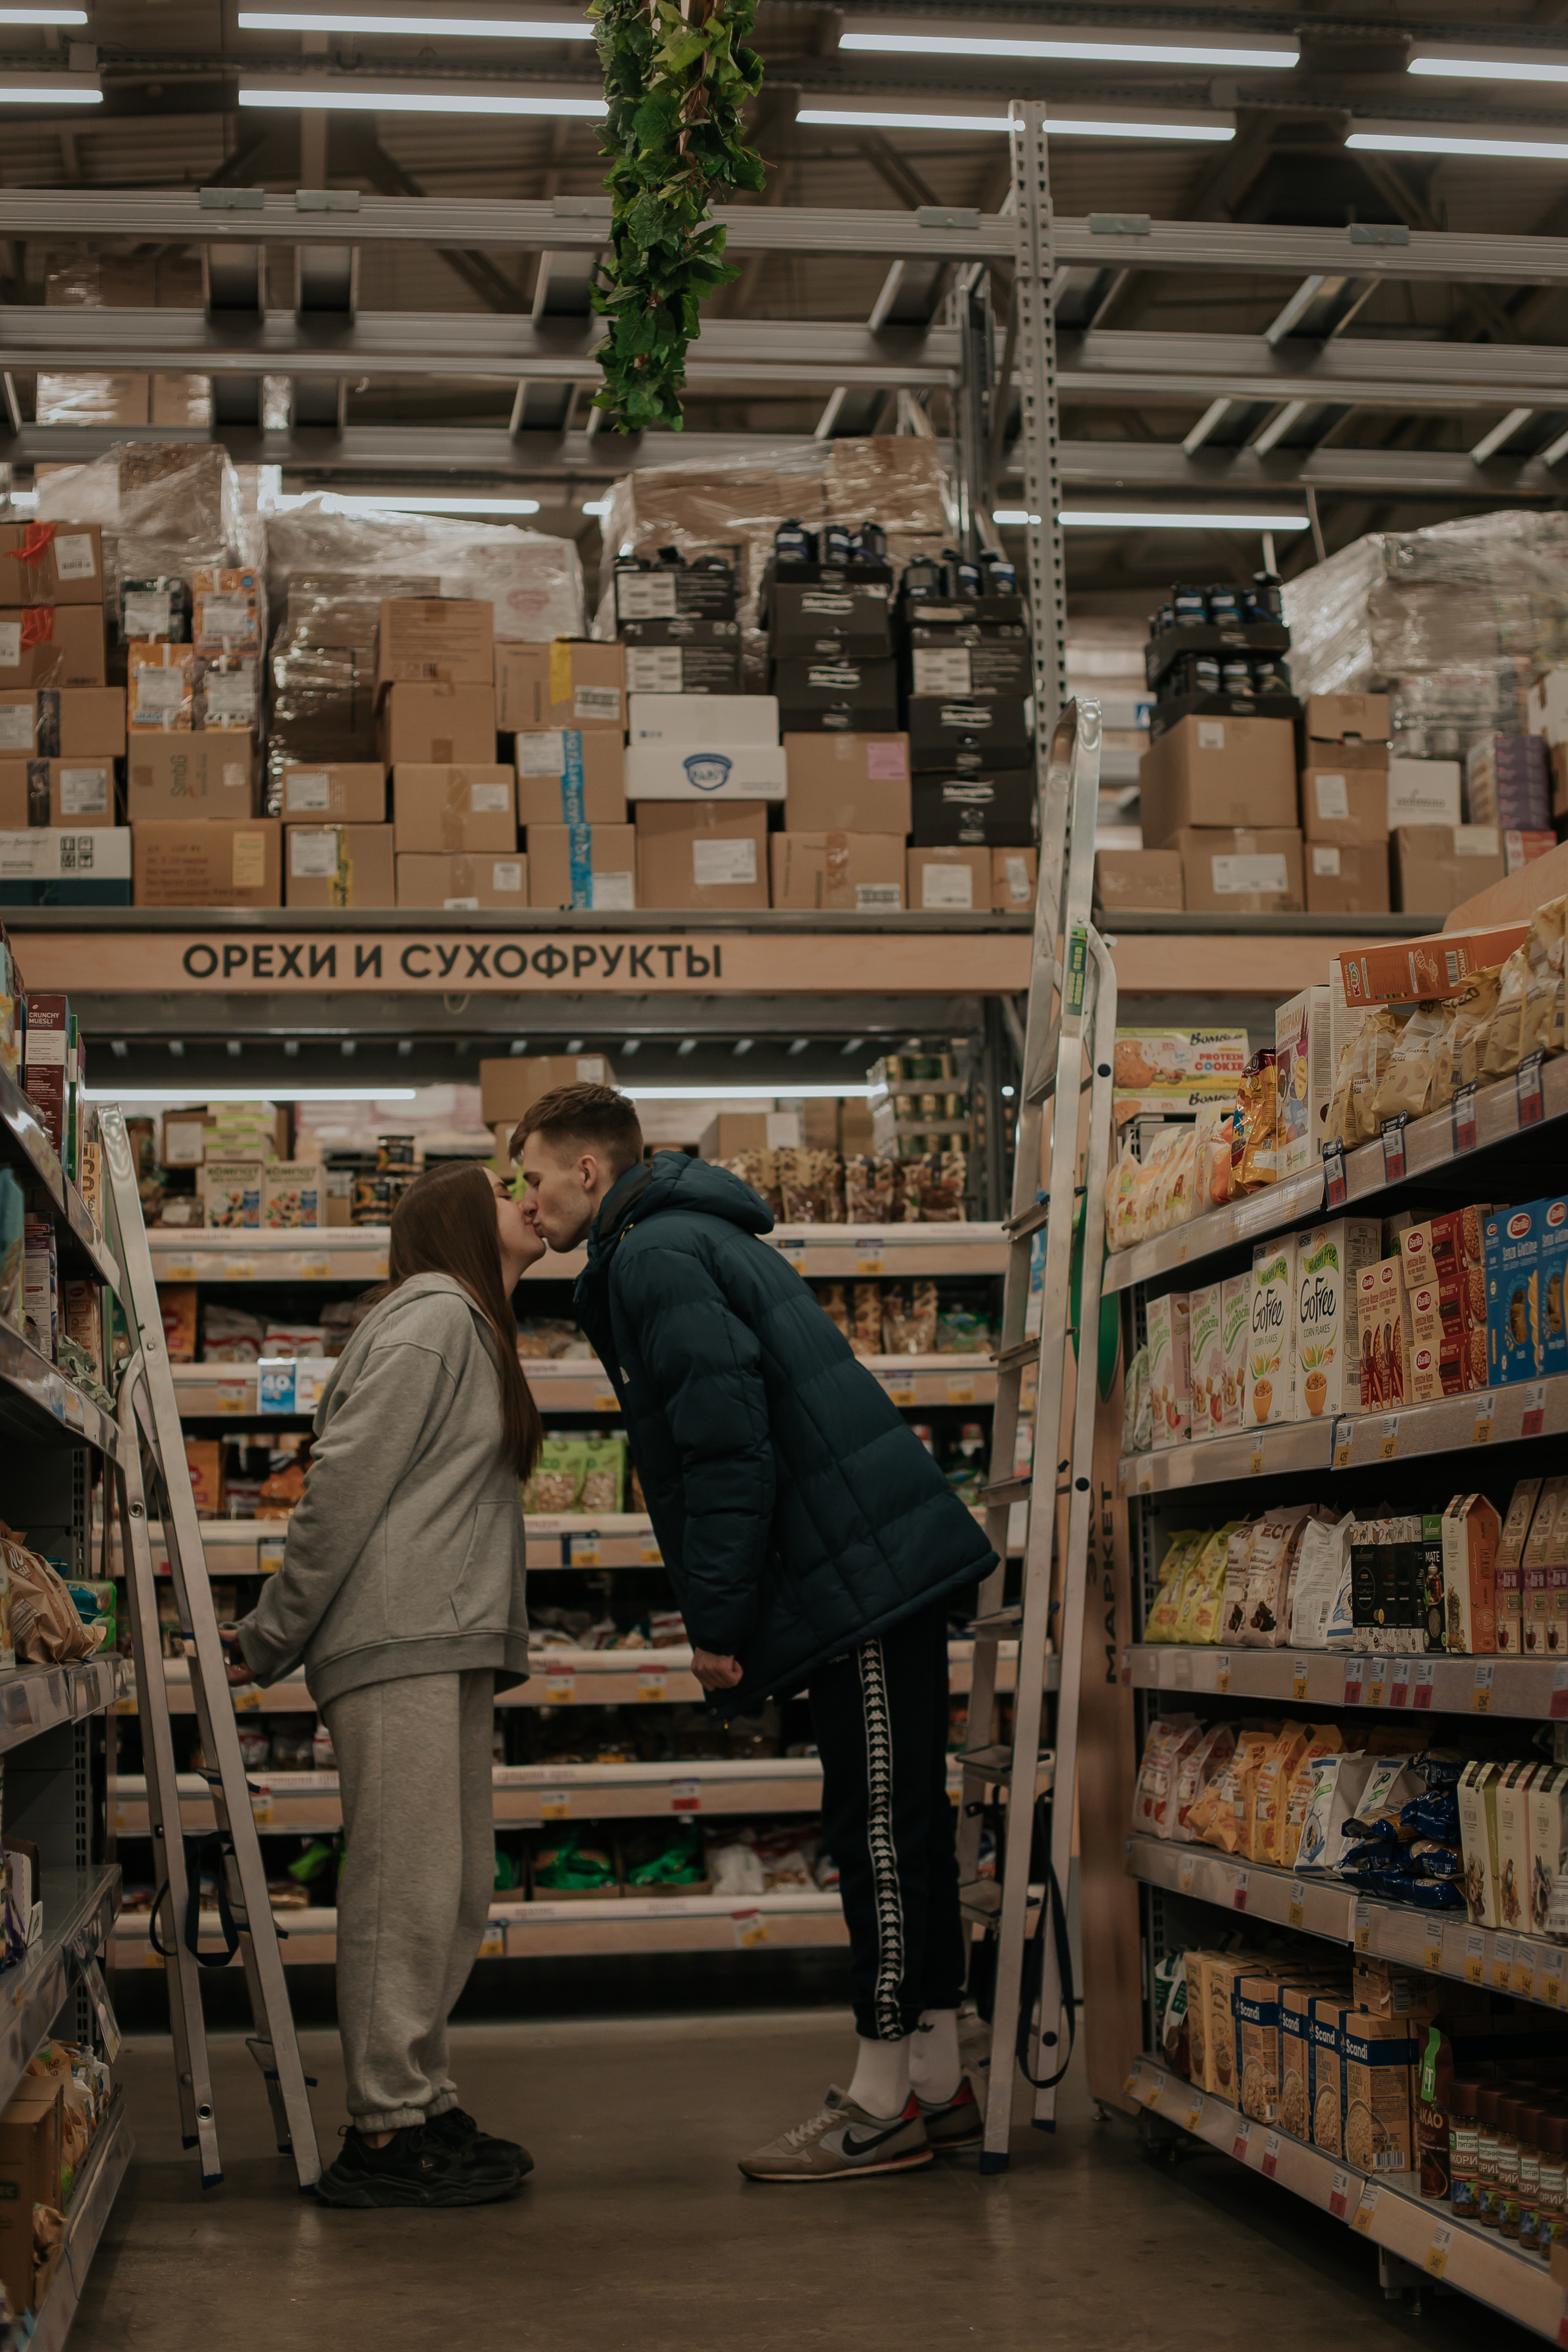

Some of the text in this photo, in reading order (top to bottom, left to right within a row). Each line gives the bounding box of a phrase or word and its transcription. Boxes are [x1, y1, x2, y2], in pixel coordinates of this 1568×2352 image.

[183, 943, 722, 979] ОРЕХИ И СУХОФРУКТЫ
[1458, 948, 1467, 979] OOMIN
[1349, 961, 1360, 998] KIDS
[1195, 1062, 1244, 1071] COOKIE
[1512, 1218, 1529, 1232] Barilla
[1409, 1232, 1423, 1249] Barilla
[1275, 1259, 1287, 1278] free
[1308, 1253, 1324, 1273] gluten
[1324, 1246, 1336, 1265] free
[1362, 1276, 1374, 1287] Barilla
[1382, 1270, 1393, 1280] Barilla
[1417, 1294, 1431, 1307] Barilla
[1254, 1334, 1278, 1347] CORN FLAKES
[1303, 1324, 1330, 1338] CORN FLAKES
[1417, 1352, 1431, 1366] Barilla
[1101, 1482, 1117, 1684] МАРКЕТ
[1240, 2002, 1260, 2021] Scandi
[1282, 2013, 1300, 2032] Scandi
[1314, 2025, 1335, 2046] Scand
[1346, 2038, 1368, 2060] Scandi
[1419, 2107, 1444, 2129] АКАО
